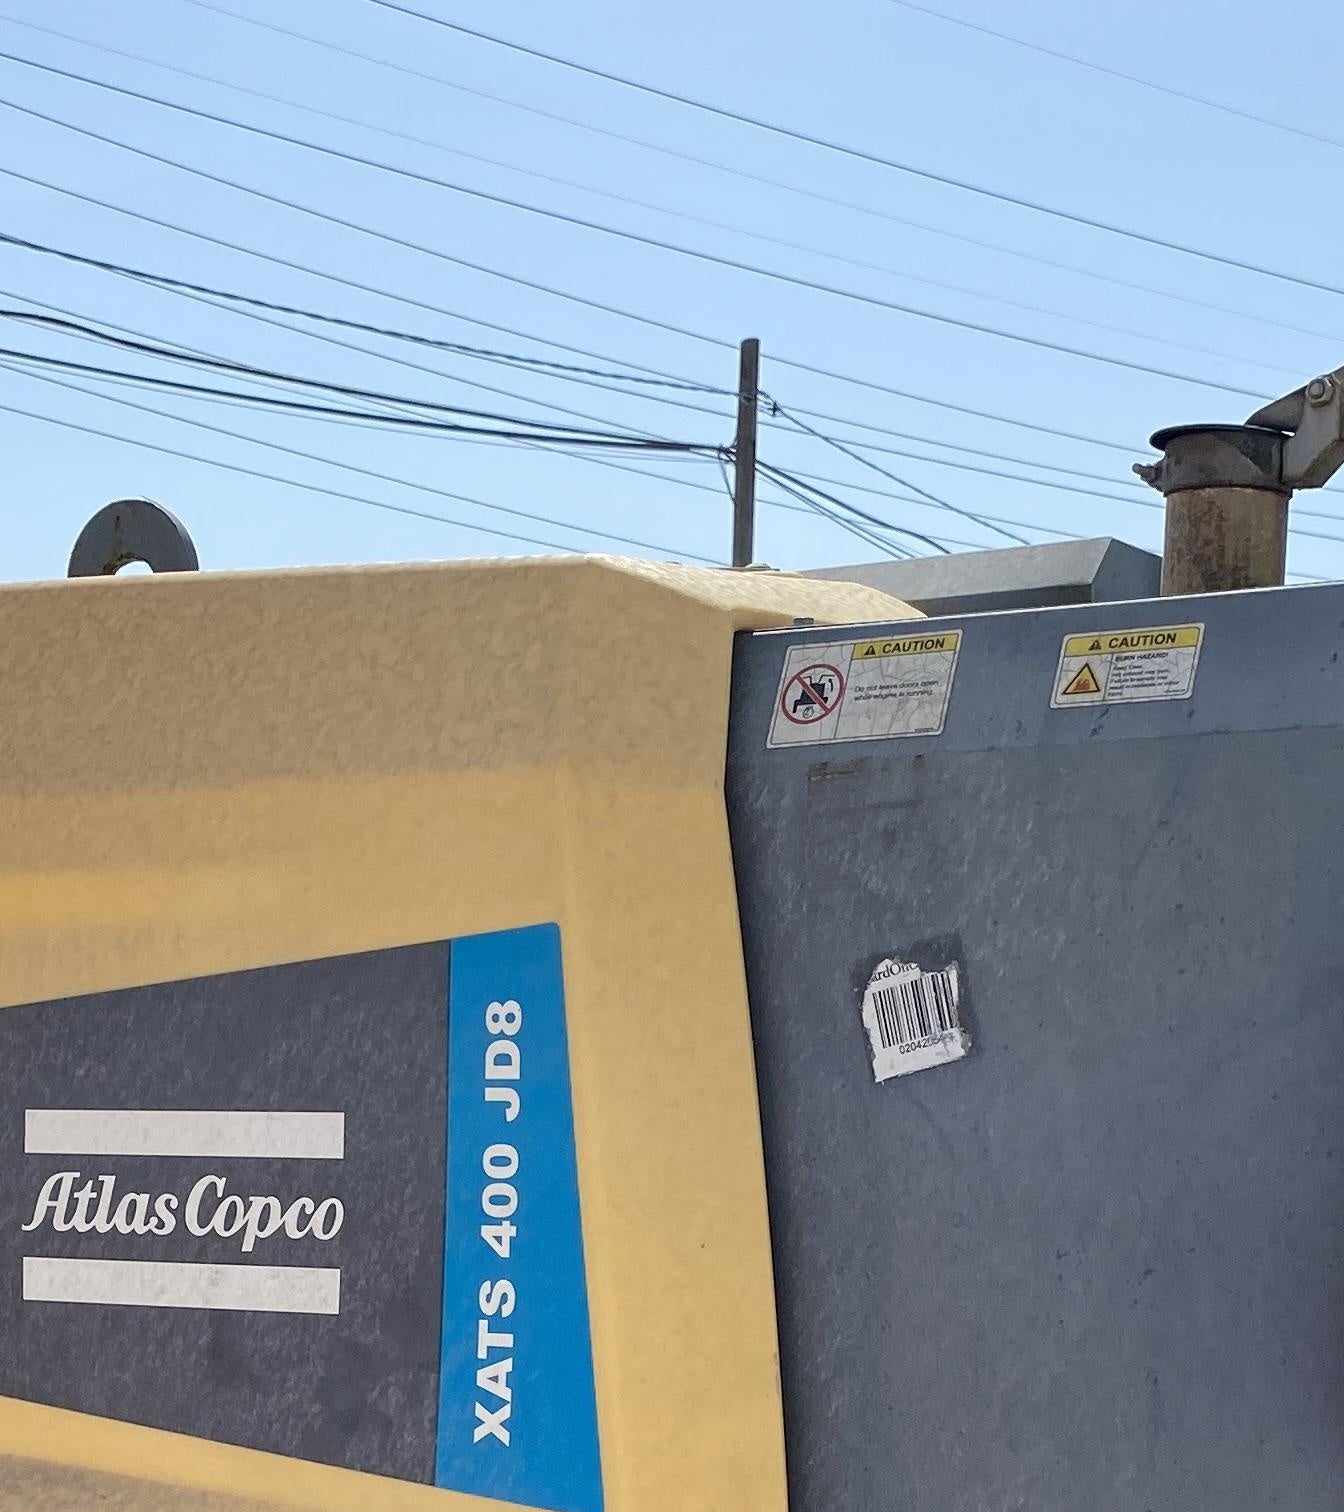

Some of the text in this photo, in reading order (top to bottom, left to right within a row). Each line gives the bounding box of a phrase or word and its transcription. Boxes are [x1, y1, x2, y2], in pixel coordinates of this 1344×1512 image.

[882, 638, 946, 654] CAUTION
[1108, 633, 1177, 649] CAUTION
[1115, 654, 1136, 662] BURN
[22, 1171, 345, 1252] Atlas Copco
[473, 999, 523, 1447] XATS 400 JD8
